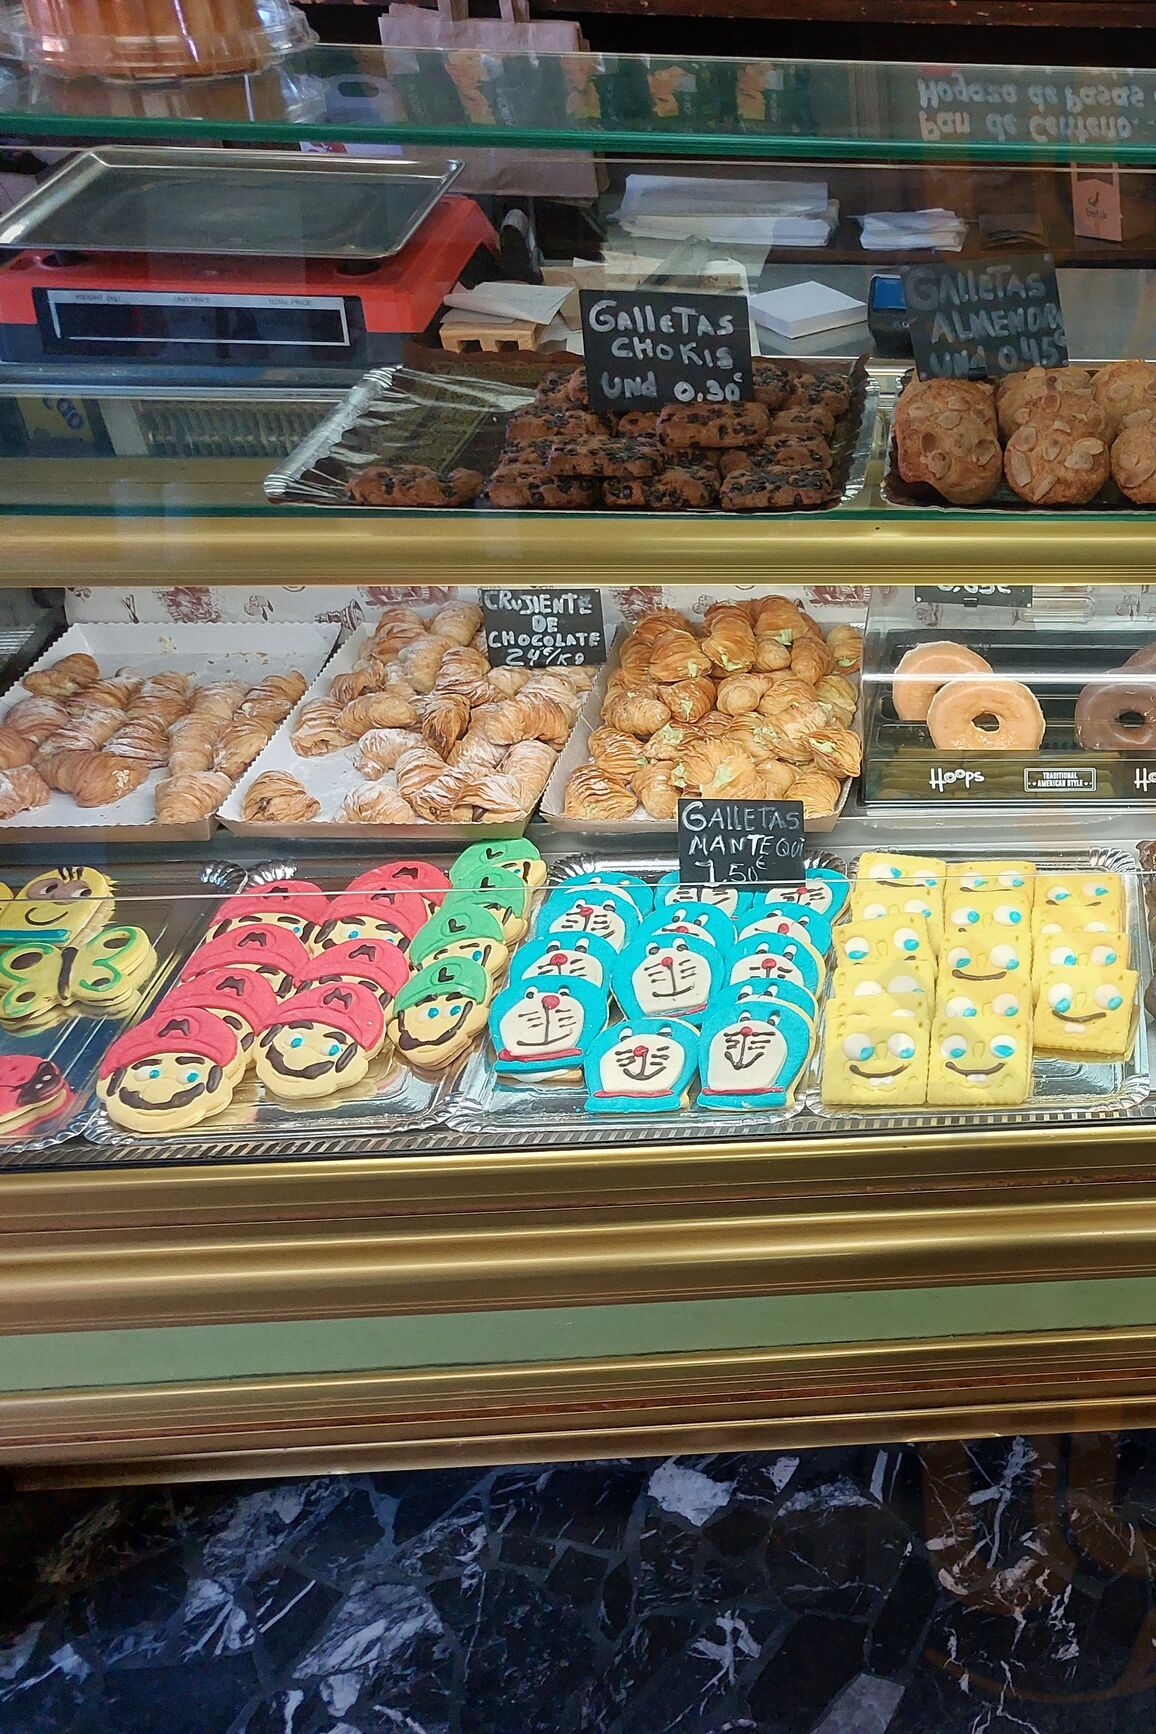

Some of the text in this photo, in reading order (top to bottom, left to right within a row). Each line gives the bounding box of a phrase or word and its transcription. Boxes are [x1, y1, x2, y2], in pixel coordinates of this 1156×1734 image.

[611, 336, 734, 370] CHOKIS
[531, 614, 559, 633] DE
[487, 630, 601, 648] CHOCOLATE
[928, 767, 986, 793] Hoops
[1037, 779, 1084, 788] AMERICAN STYLE
[1042, 771, 1079, 780] TRADITIONAL
